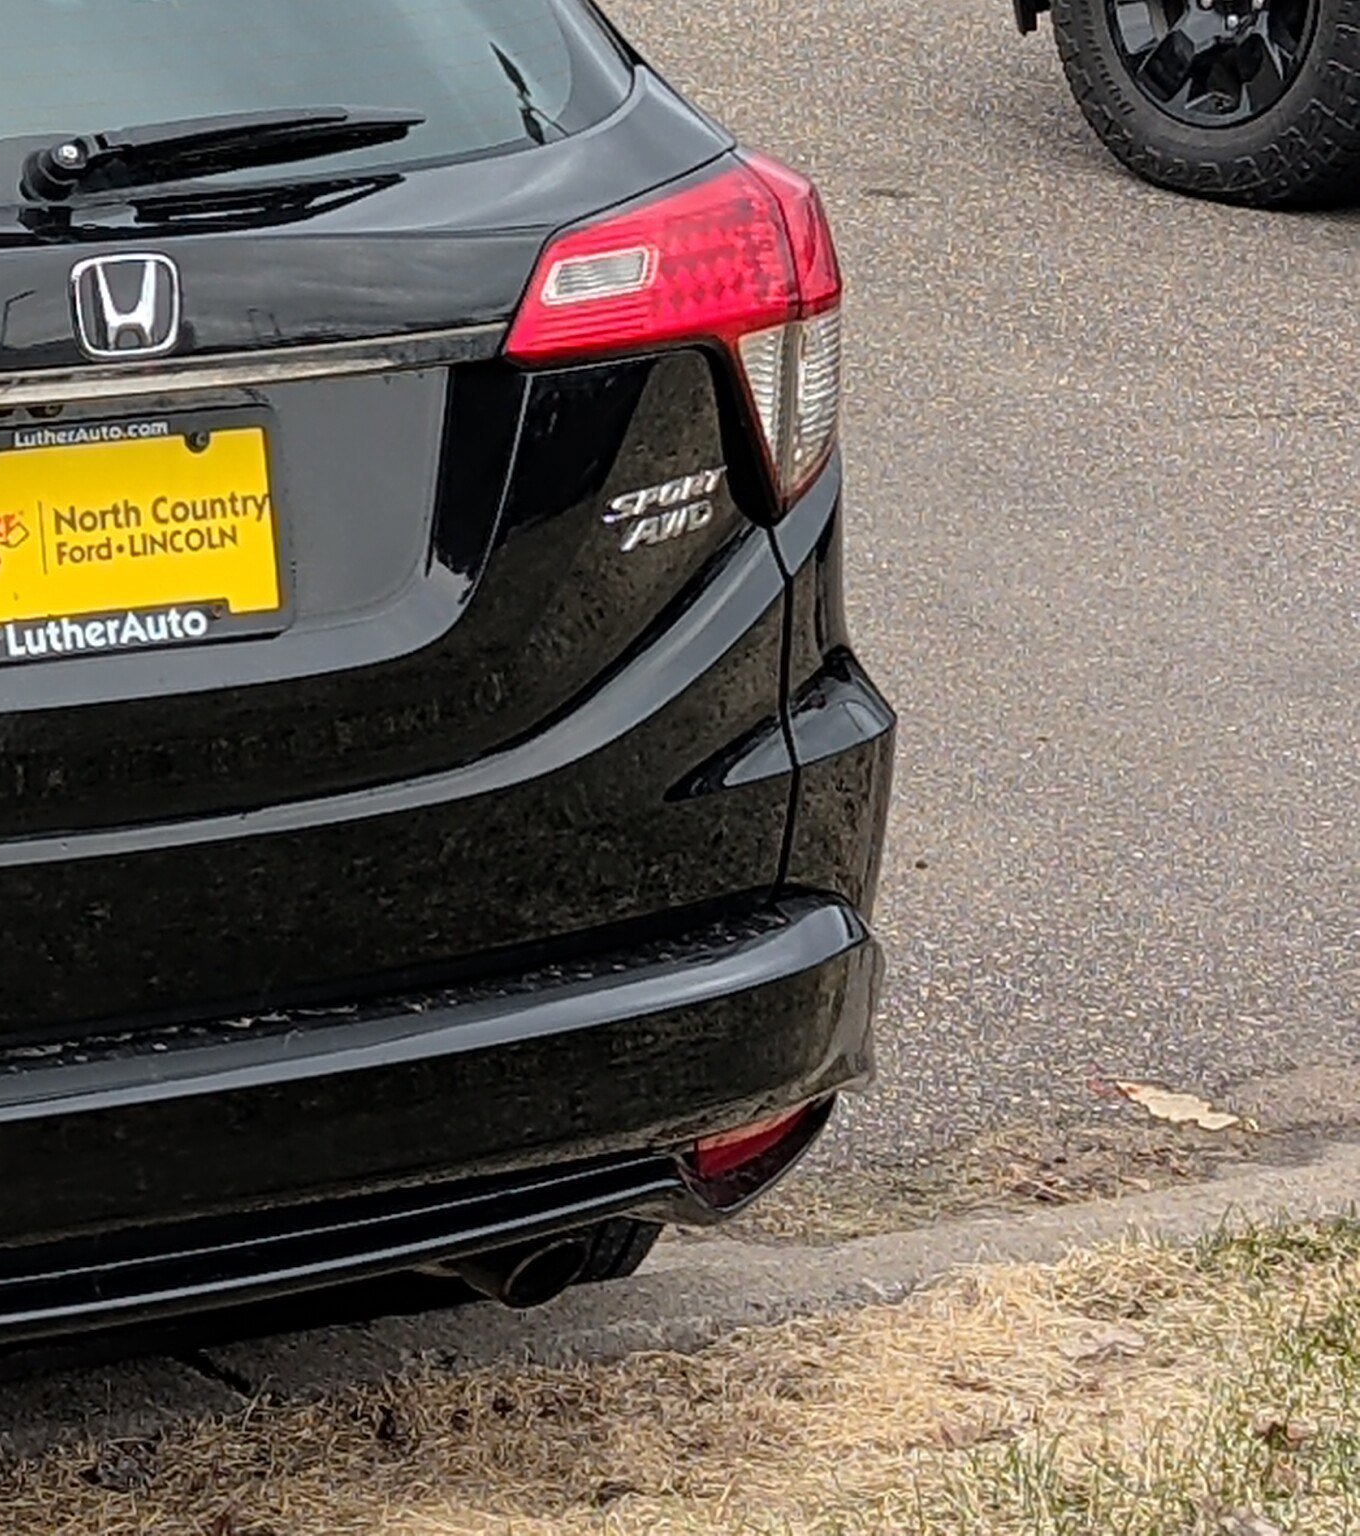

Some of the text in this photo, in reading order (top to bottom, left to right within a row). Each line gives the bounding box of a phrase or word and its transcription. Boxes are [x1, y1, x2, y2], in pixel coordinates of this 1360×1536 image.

[14, 421, 169, 448] LutherAuto.com
[53, 491, 270, 535] North Country
[56, 524, 238, 566] Ford LINCOLN
[5, 607, 208, 656] LutherAuto
